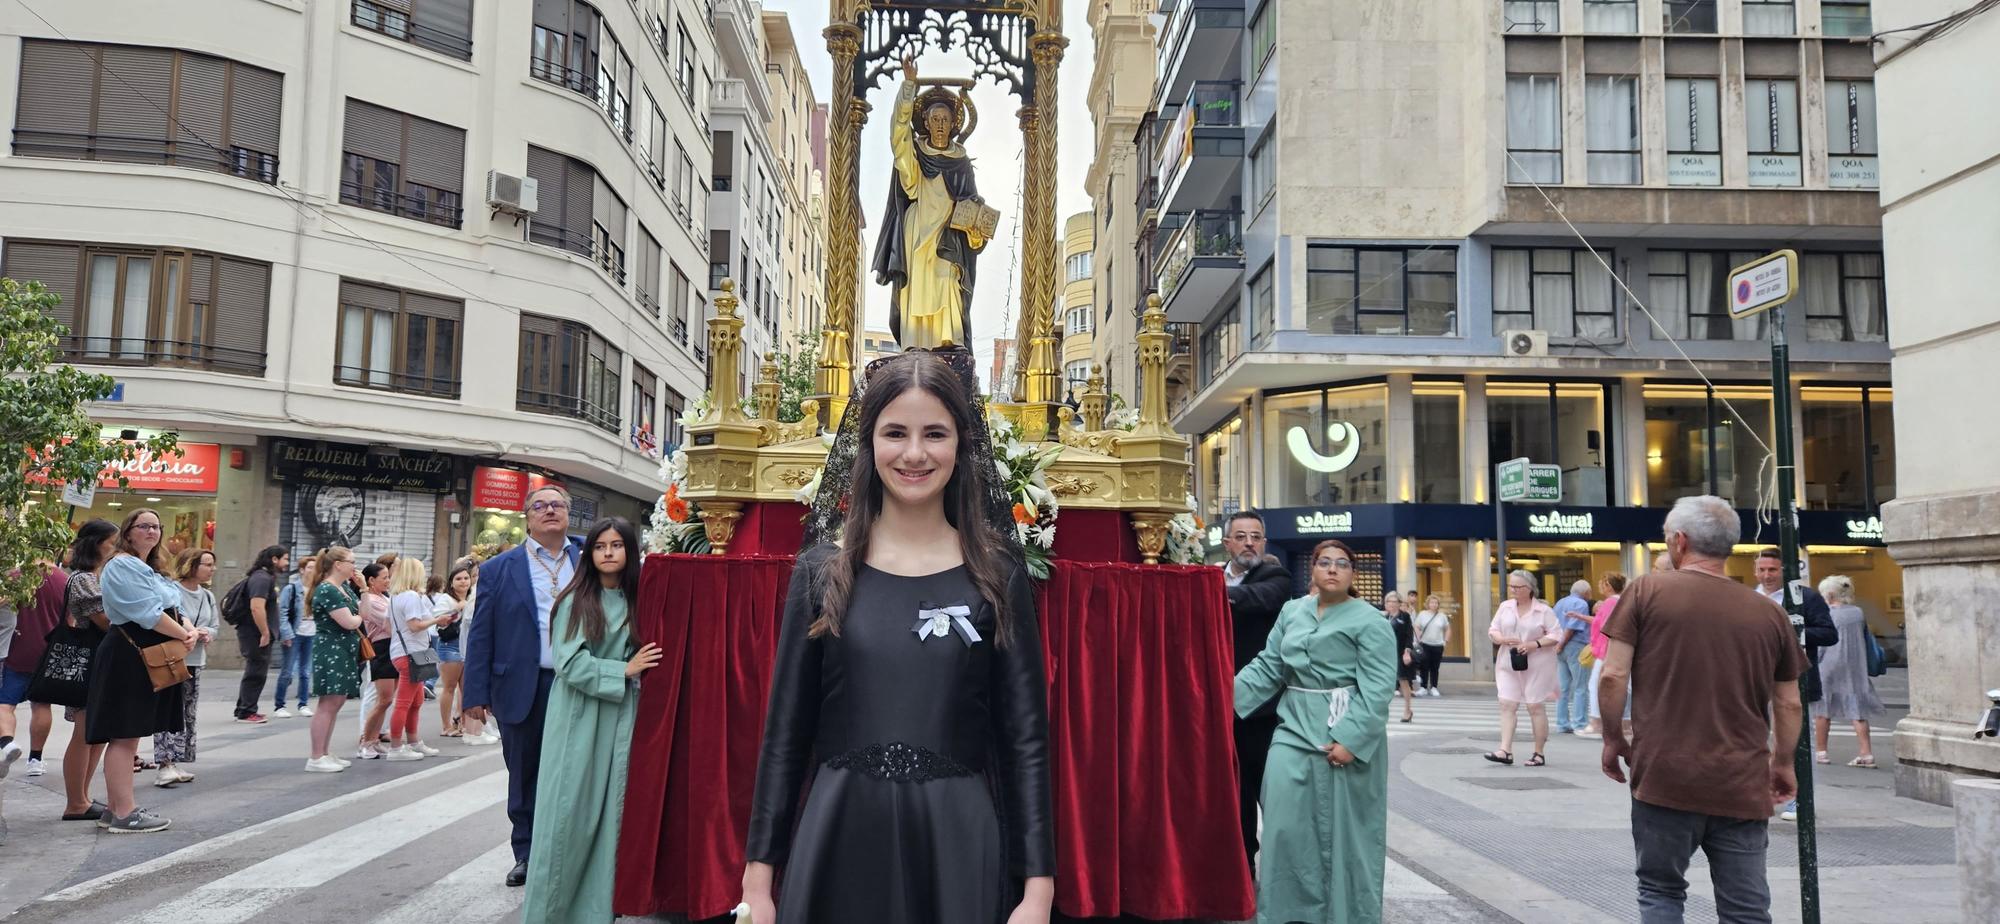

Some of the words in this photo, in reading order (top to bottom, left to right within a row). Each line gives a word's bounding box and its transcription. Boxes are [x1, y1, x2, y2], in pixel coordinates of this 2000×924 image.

[1851, 117, 1859, 150] SALUD
[1681, 157, 1704, 166] QOA
[1761, 158, 1784, 167] QOA
[1841, 159, 1864, 168] QOA
[1862, 172, 1876, 180] 251
[285, 446, 369, 468] RELOJERIA
[303, 467, 357, 484] Relojeros
[362, 471, 394, 485] desde
[486, 472, 519, 483] CARAMELOS
[481, 488, 502, 497] FRUTOS
[502, 490, 520, 499] SECOS
[482, 497, 518, 507] CHOCOLATES
[1313, 511, 1353, 527] Aural
[1548, 510, 1593, 528] Aural
